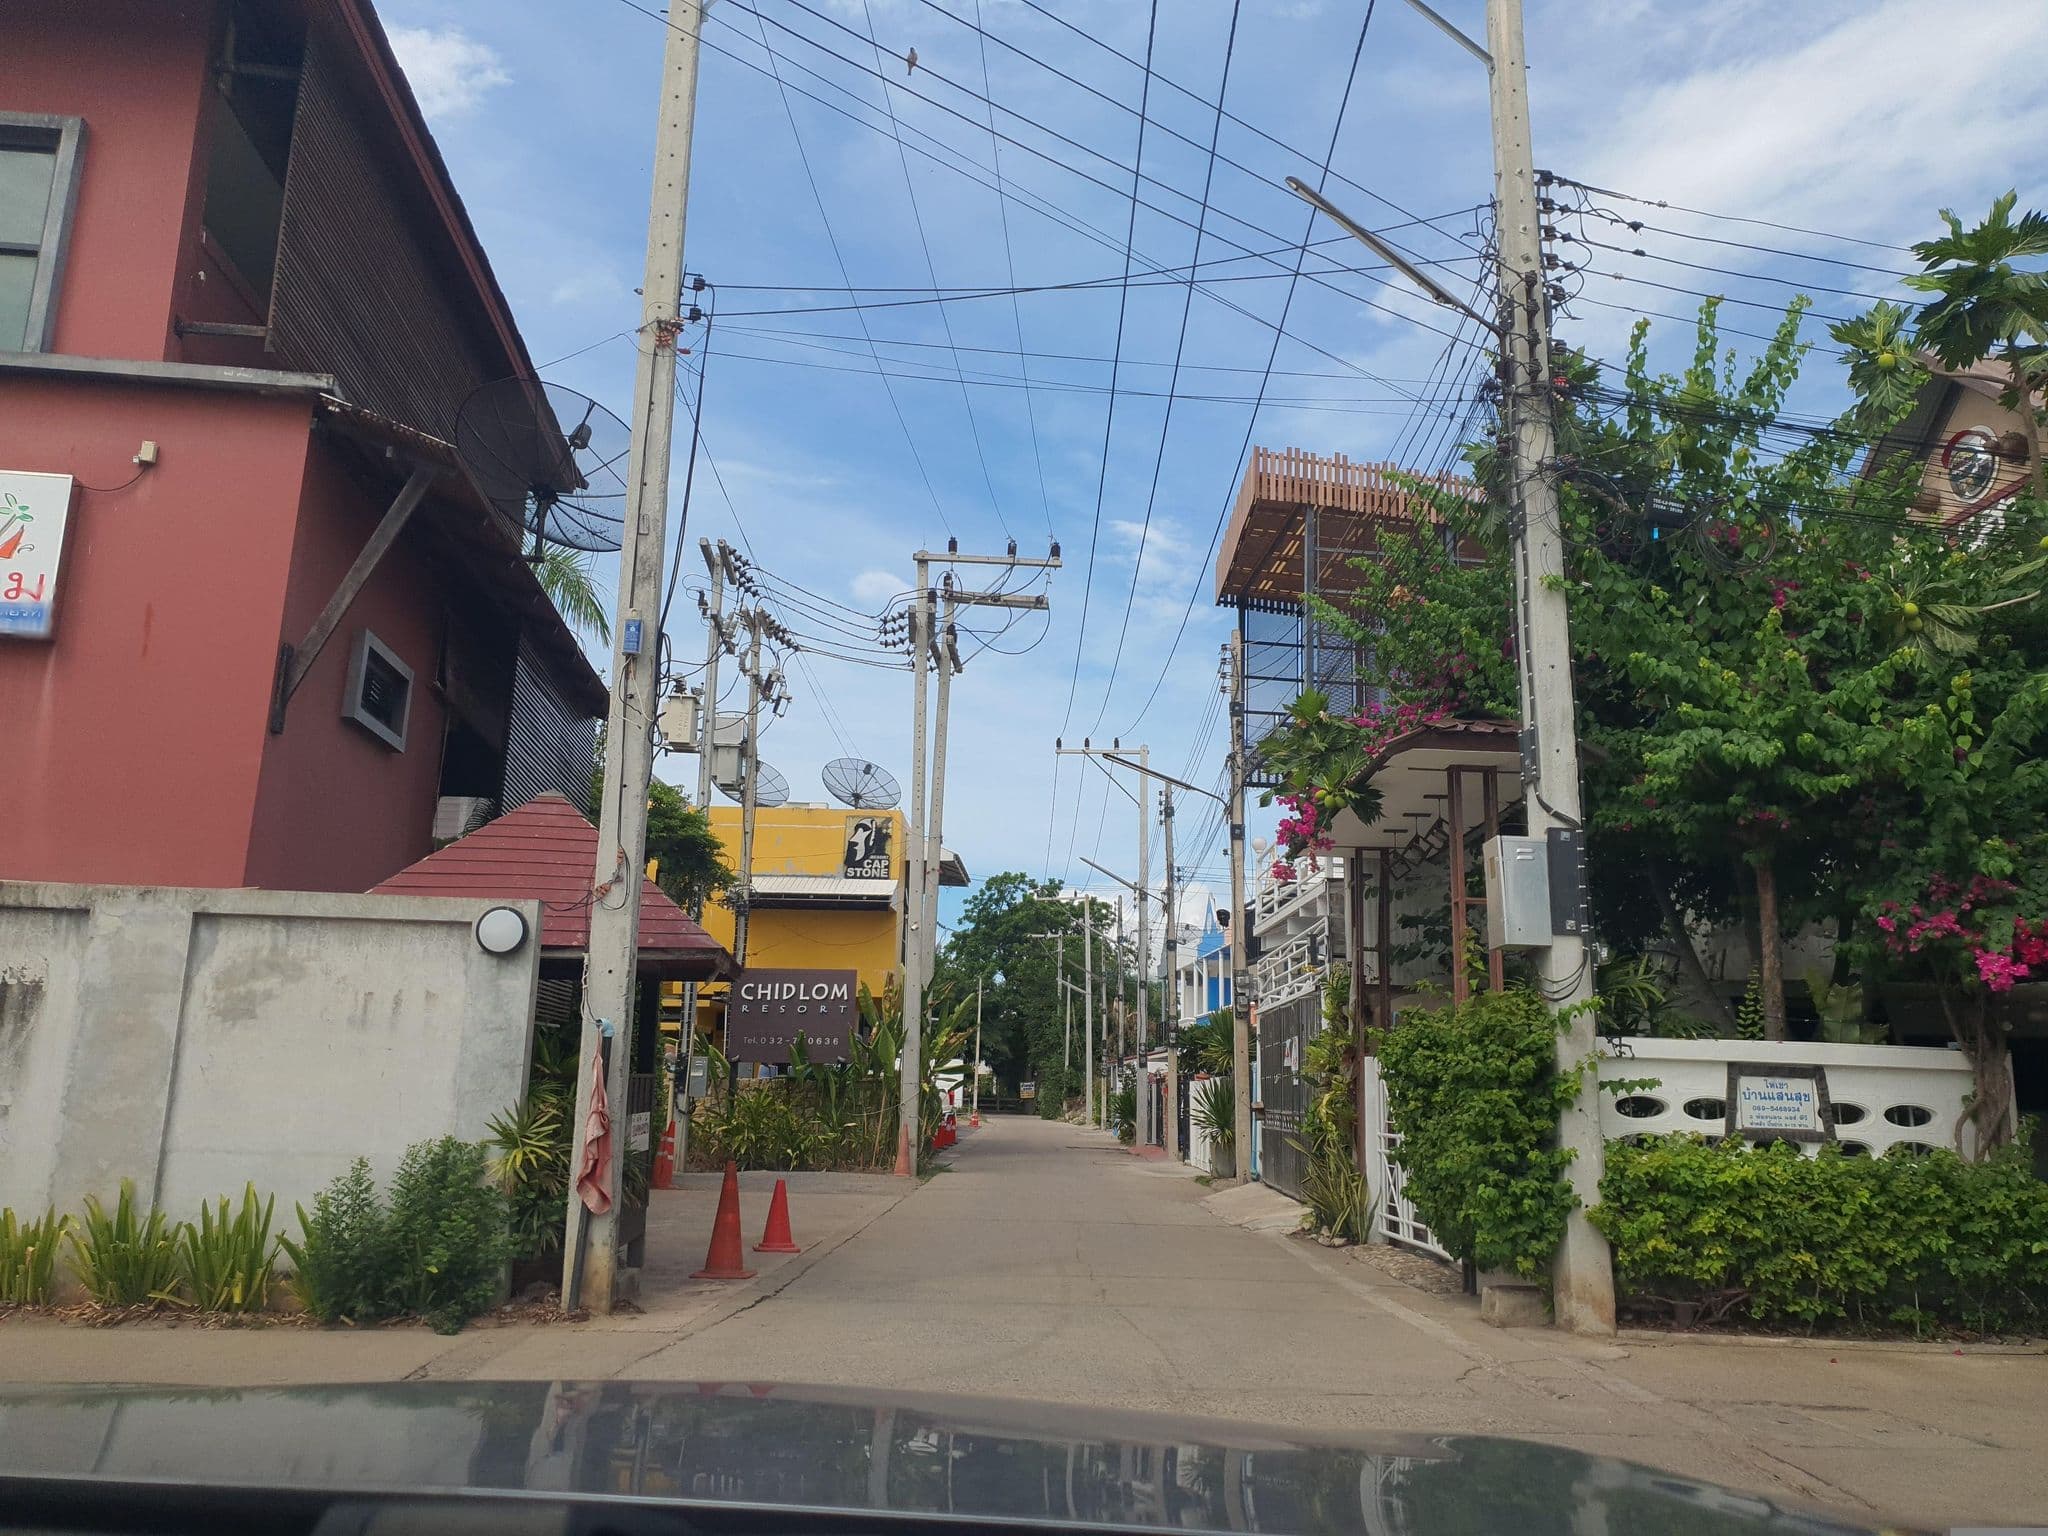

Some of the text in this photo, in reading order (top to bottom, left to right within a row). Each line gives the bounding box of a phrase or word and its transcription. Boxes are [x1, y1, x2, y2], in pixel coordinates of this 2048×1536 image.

[864, 859, 889, 869] CAP
[846, 867, 889, 878] STONE
[740, 983, 848, 1000] CHIDLOM
[741, 1004, 848, 1014] RESORT
[743, 1036, 839, 1046] Tel. 032-70636
